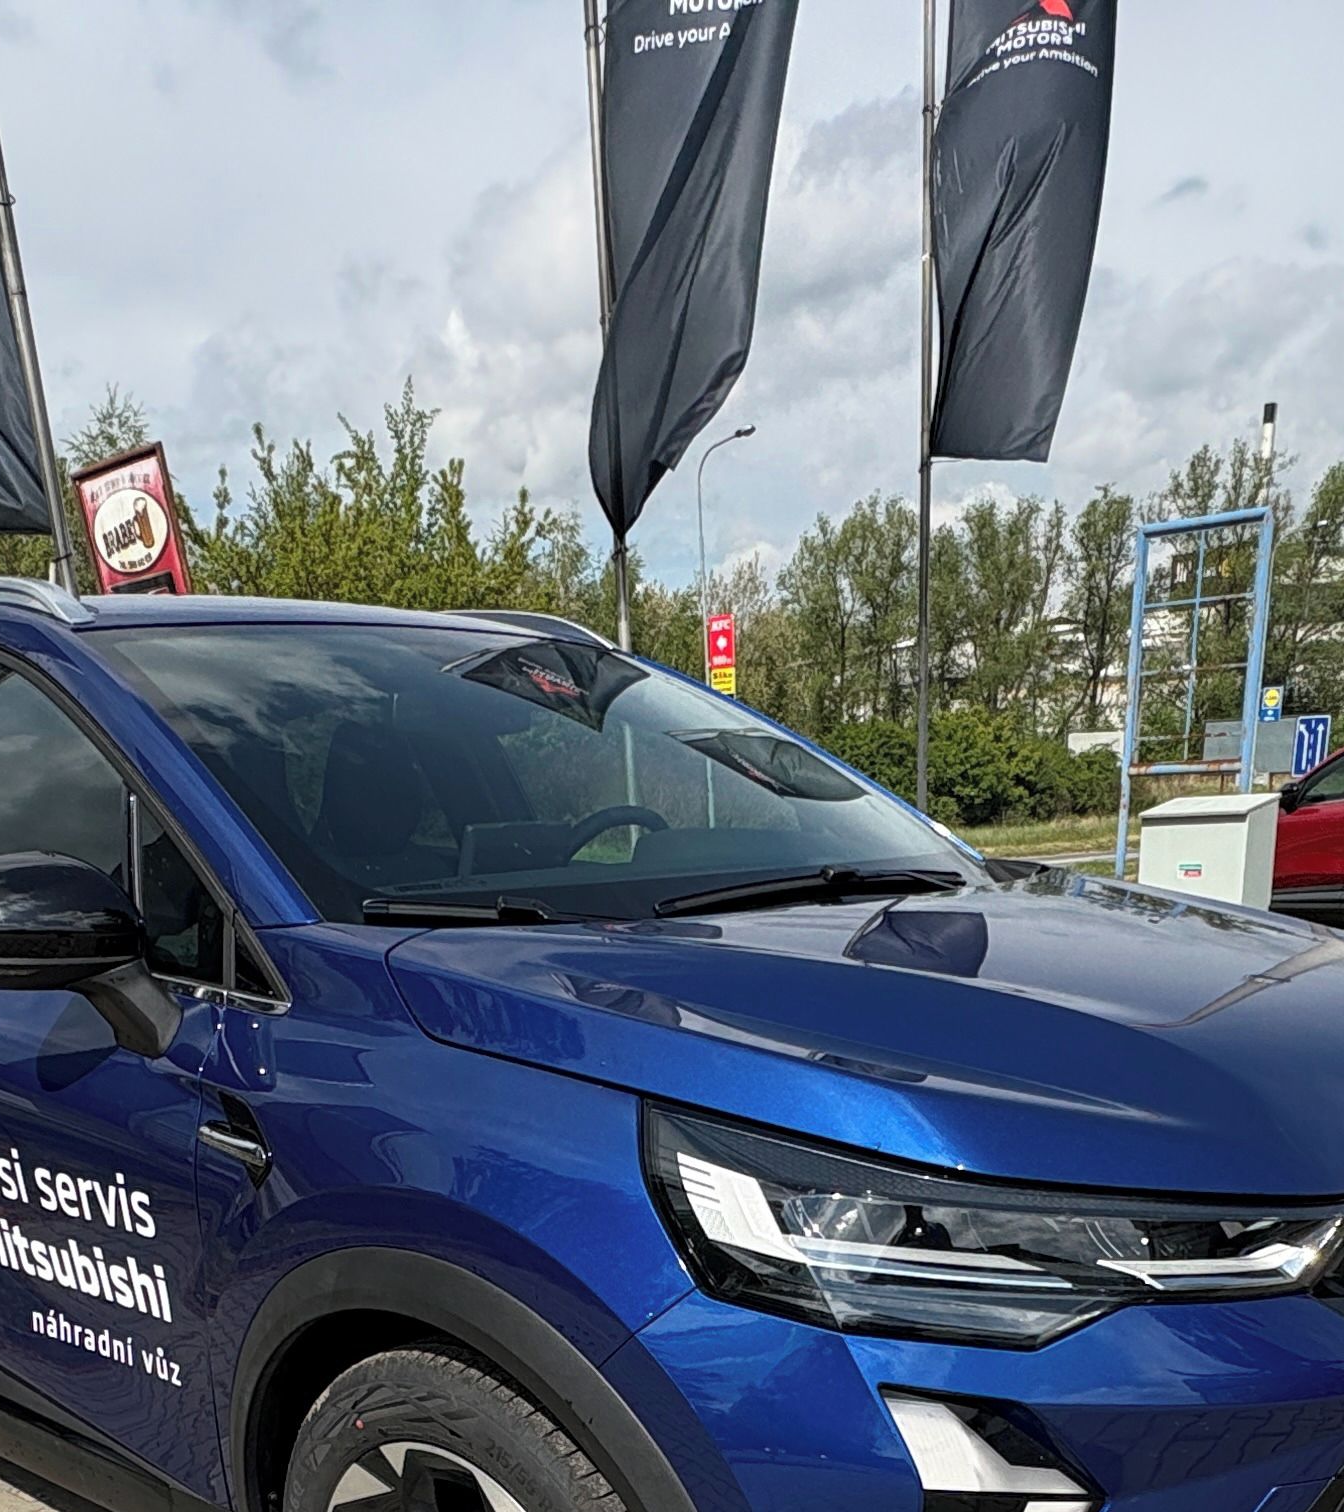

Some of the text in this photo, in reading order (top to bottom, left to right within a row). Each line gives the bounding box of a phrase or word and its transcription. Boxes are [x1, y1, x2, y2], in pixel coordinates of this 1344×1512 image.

[634, 29, 674, 54] Drive
[678, 26, 717, 48] your
[1003, 51, 1037, 70] your
[1038, 48, 1100, 78] Ambition
[33, 1171, 157, 1239] servis
[31, 1309, 183, 1387] náhradní vůz
